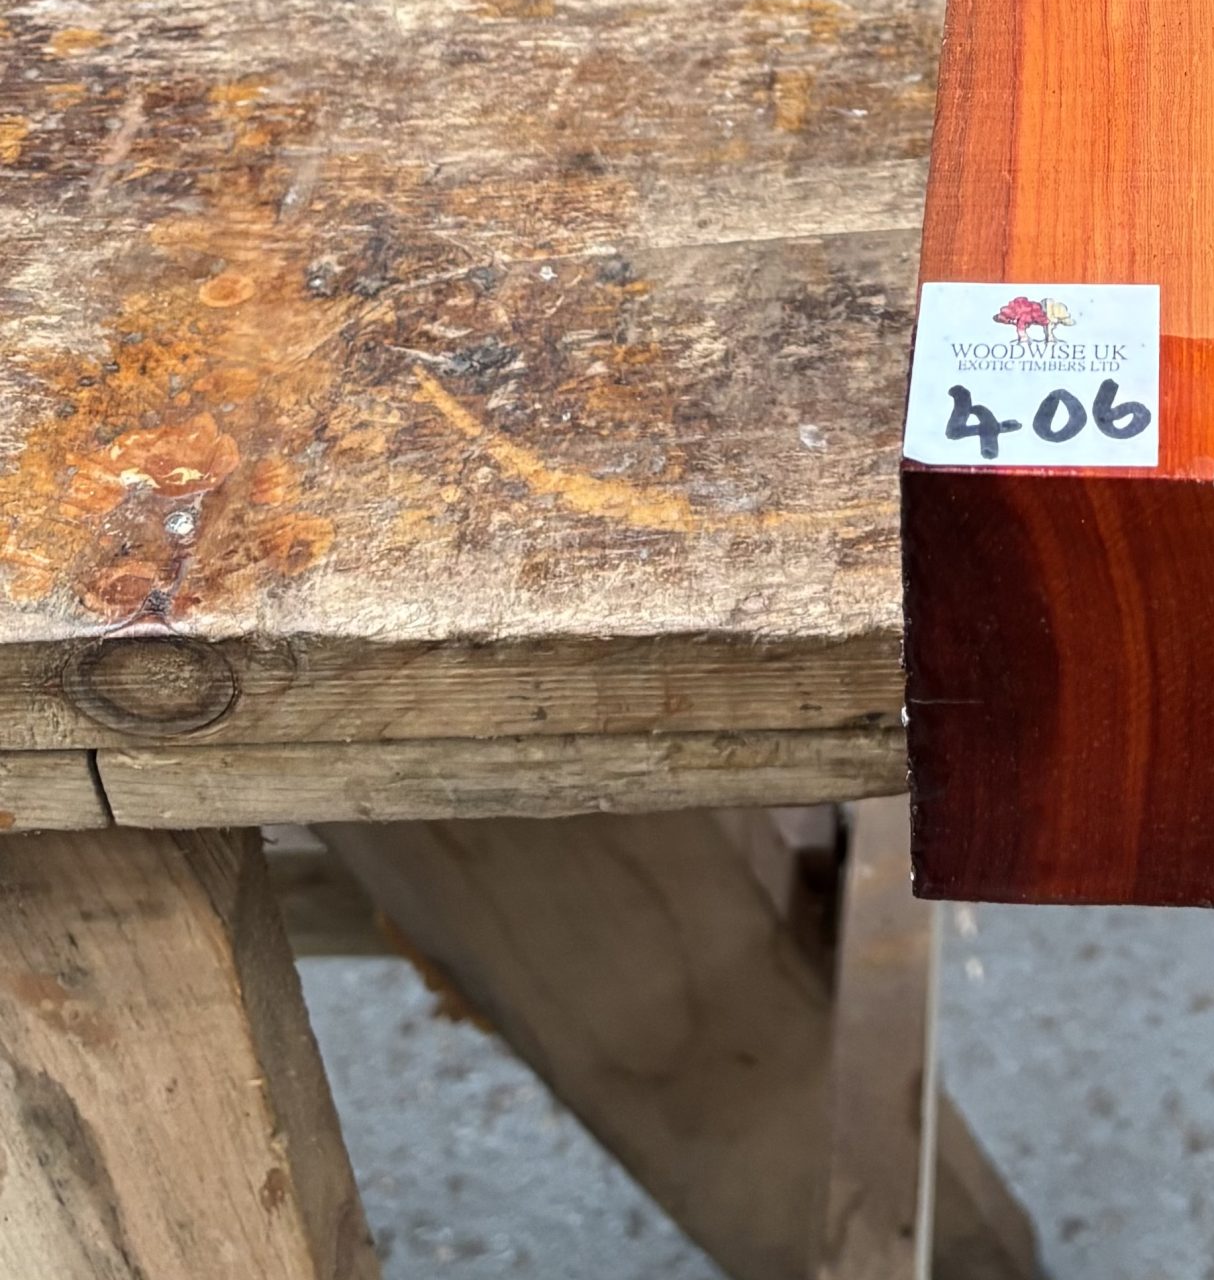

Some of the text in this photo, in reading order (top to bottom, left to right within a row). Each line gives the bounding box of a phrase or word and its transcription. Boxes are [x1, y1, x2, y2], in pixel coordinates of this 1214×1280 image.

[951, 343, 1128, 360] WOODWISE UK
[958, 360, 1120, 372] EXOTIC TIMBERS LTD
[945, 378, 1152, 460] 406
